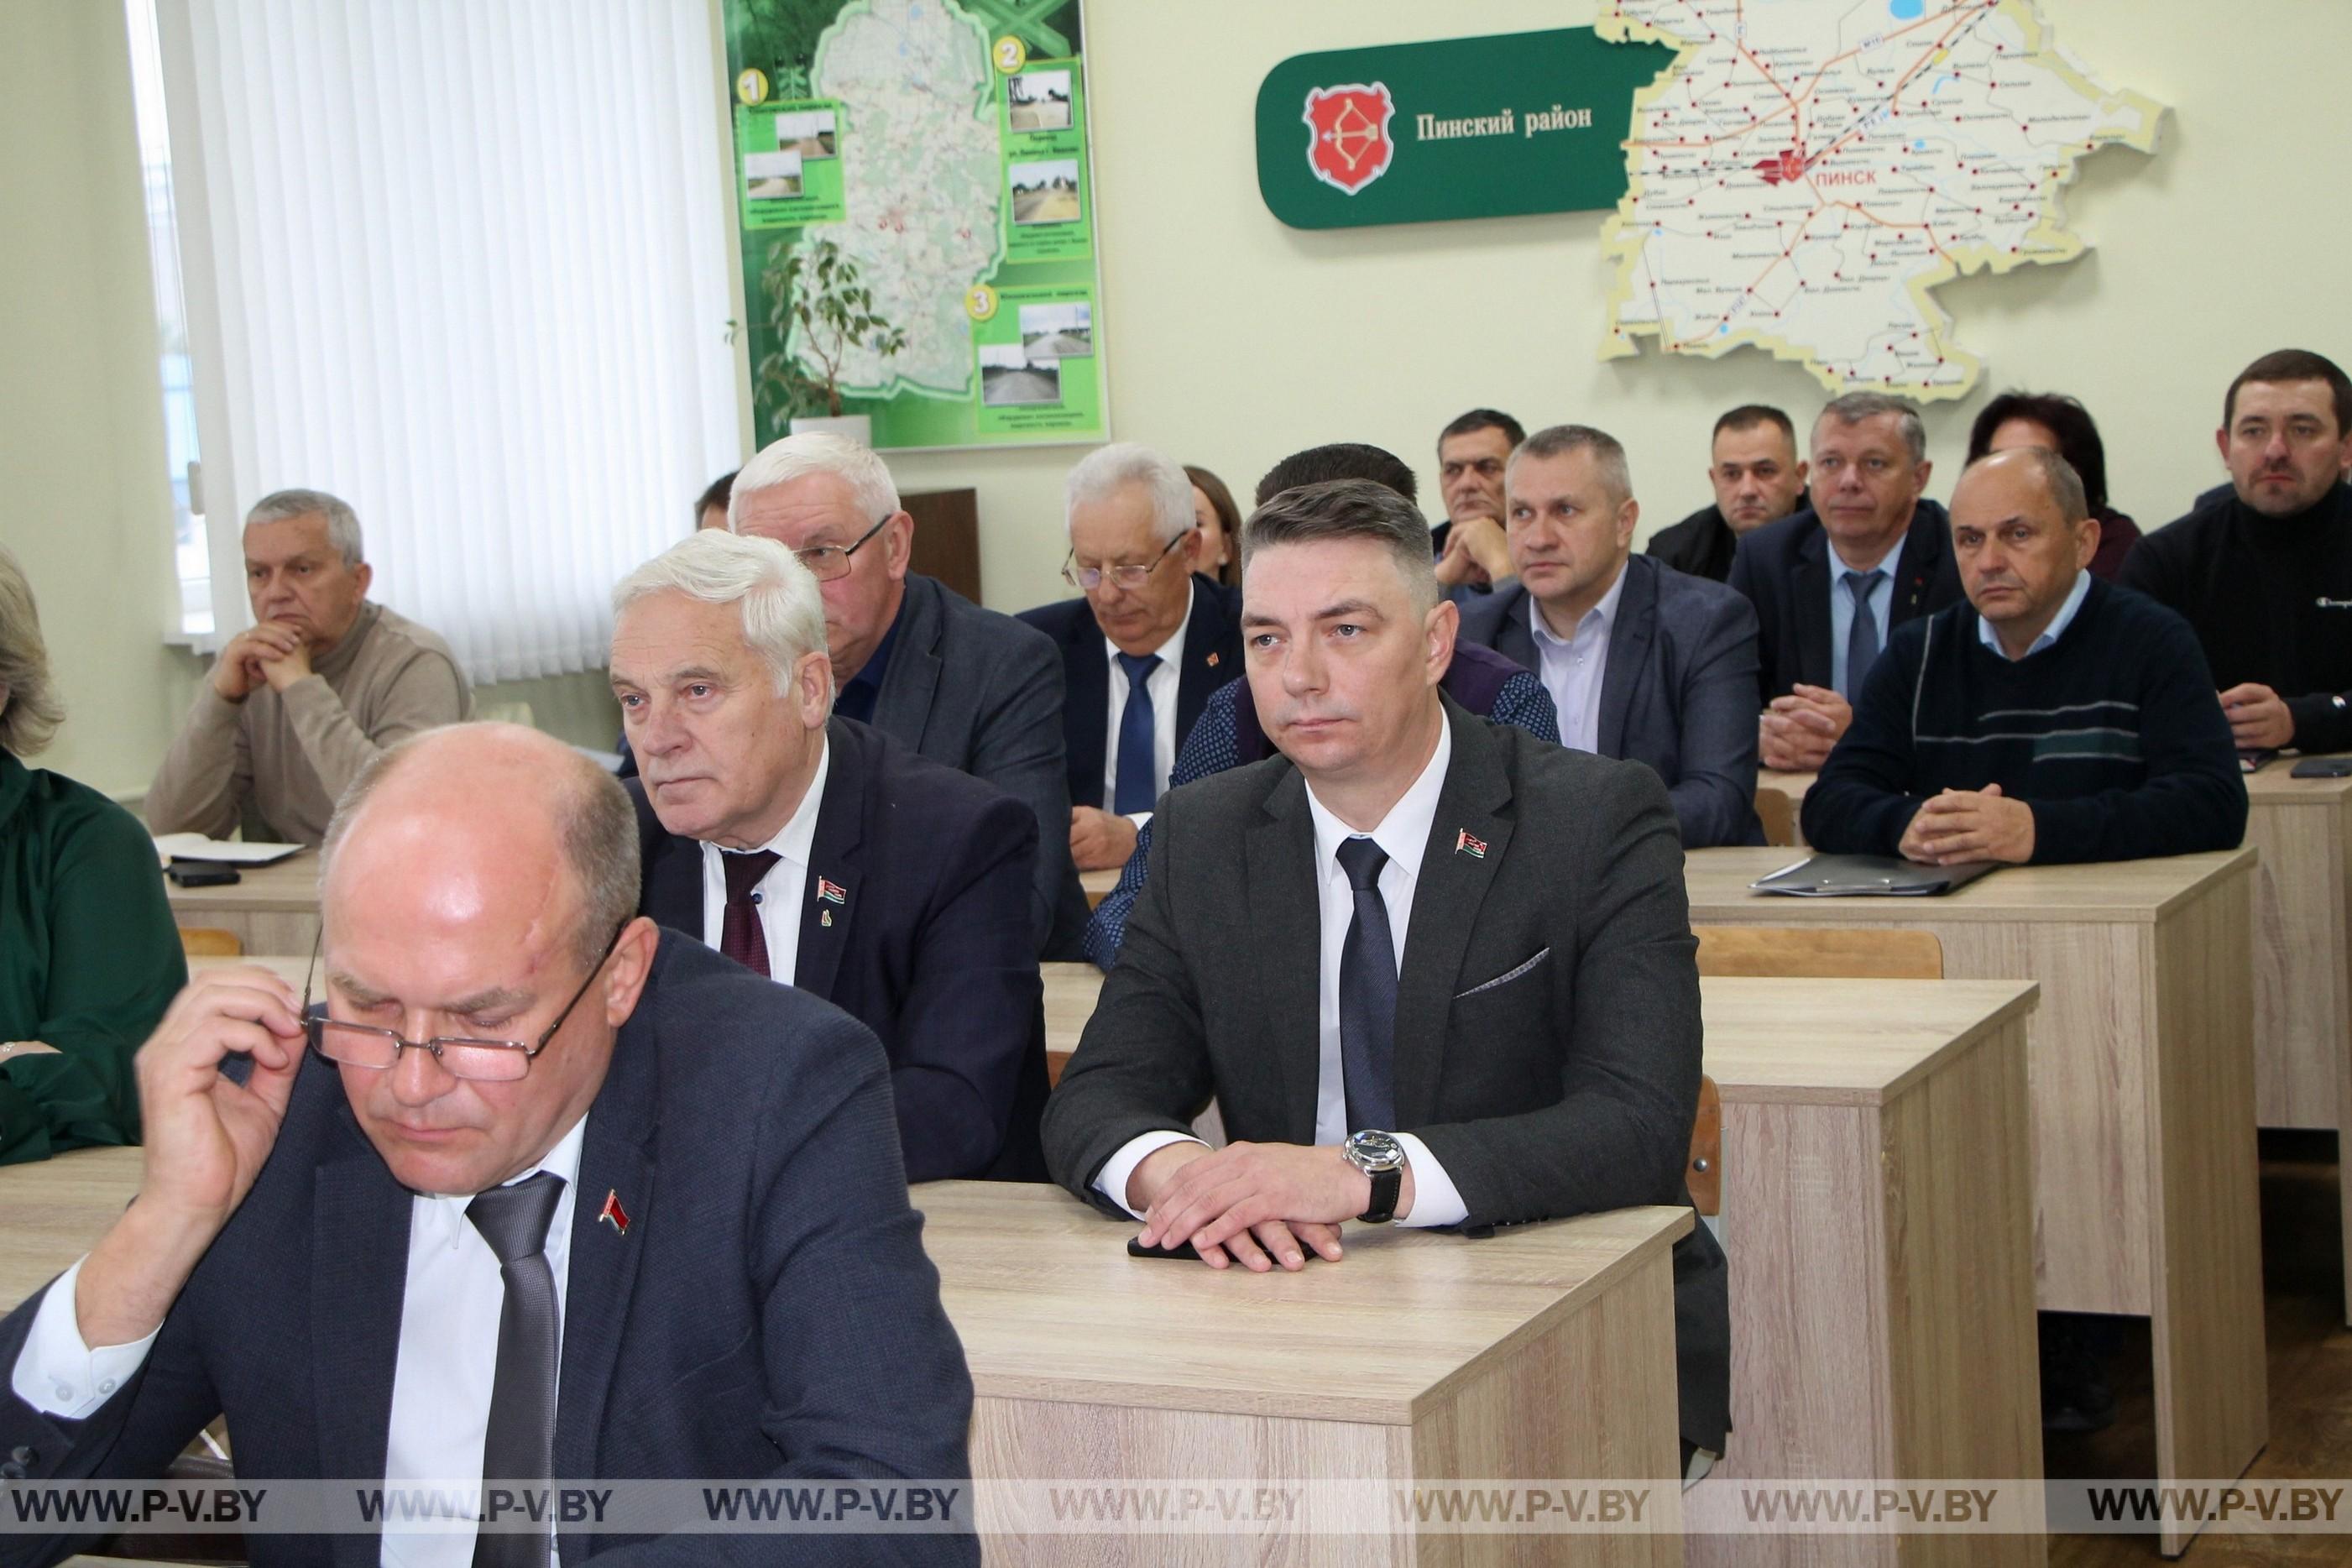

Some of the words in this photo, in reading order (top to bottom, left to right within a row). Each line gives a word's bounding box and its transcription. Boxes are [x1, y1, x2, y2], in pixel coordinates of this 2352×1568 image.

[1001, 42, 1019, 68] 2
[741, 73, 761, 101] 1
[1416, 110, 1514, 142] Пинский
[1524, 103, 1592, 139] район
[1816, 171, 1877, 186] ПИНСК
[972, 291, 990, 313] 3
